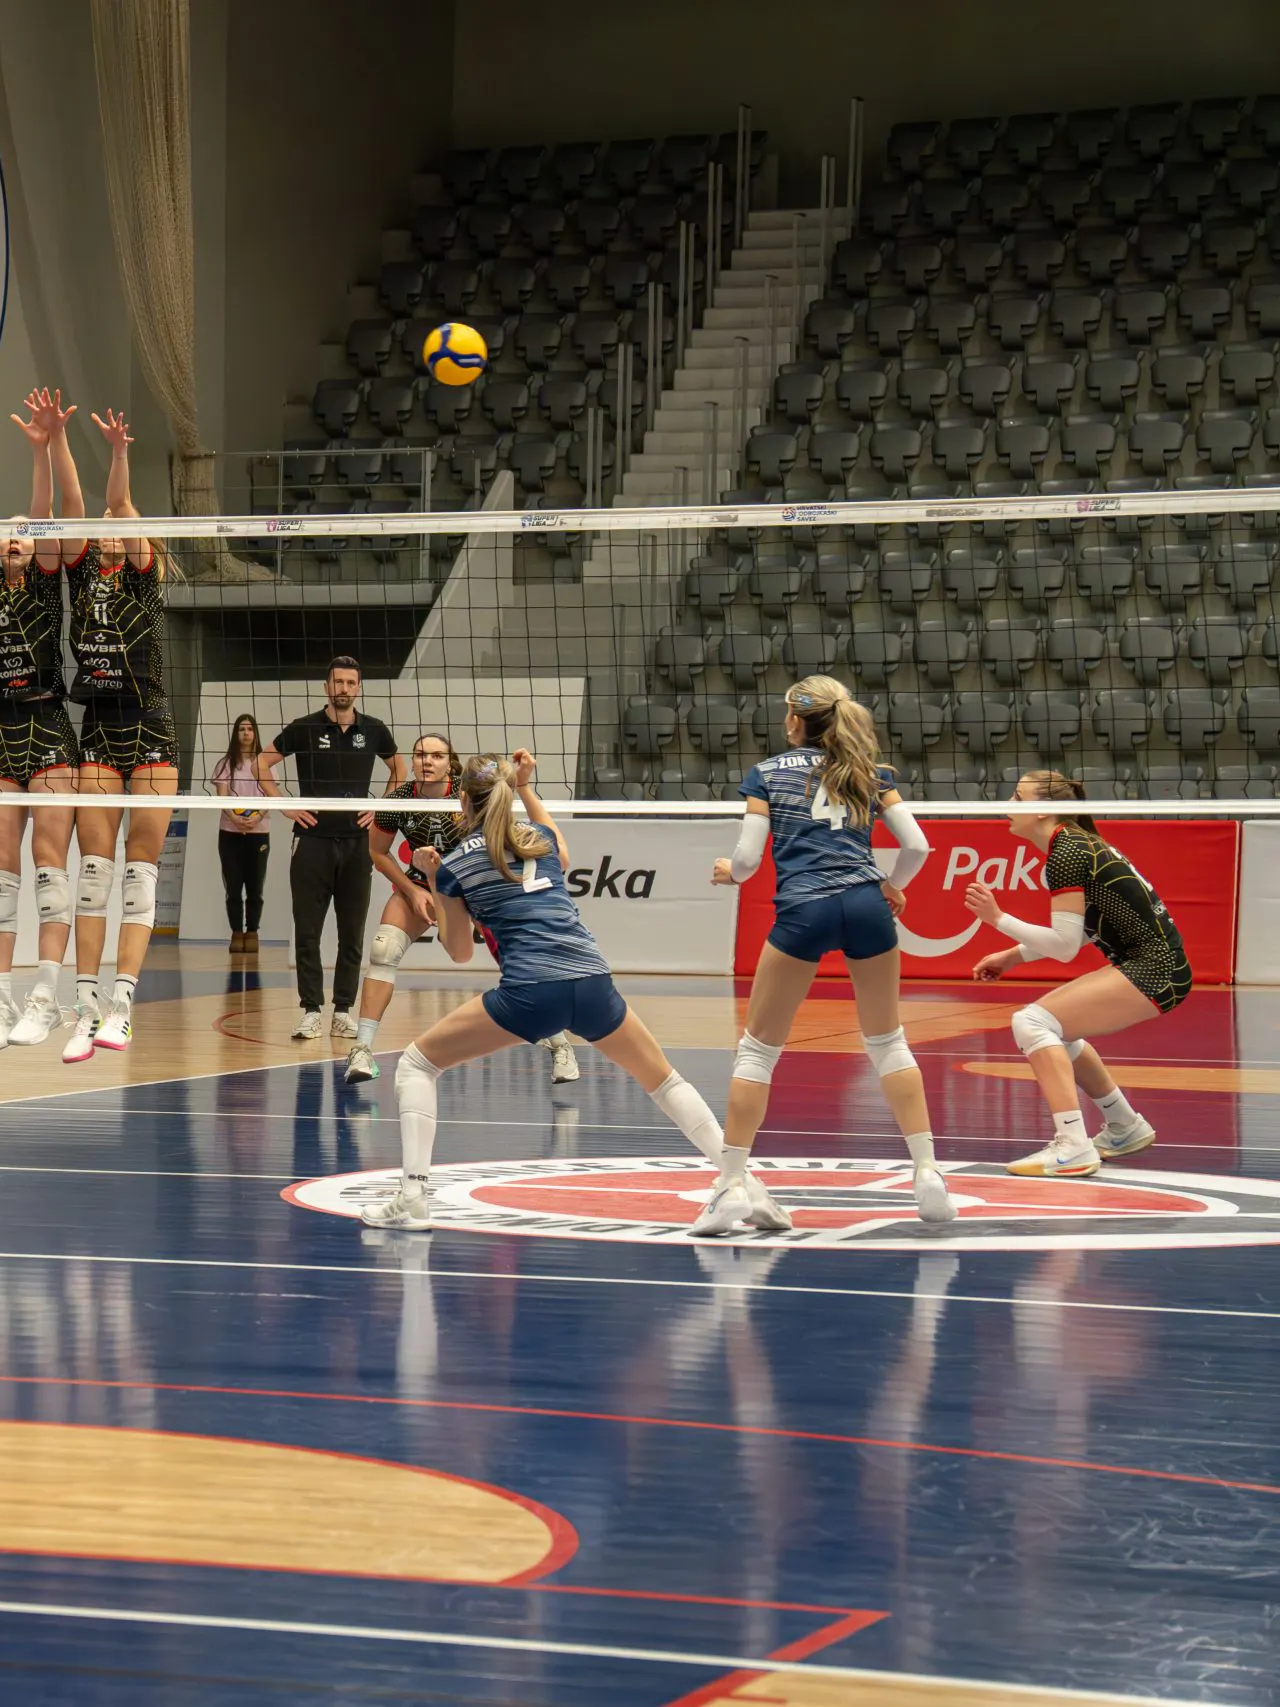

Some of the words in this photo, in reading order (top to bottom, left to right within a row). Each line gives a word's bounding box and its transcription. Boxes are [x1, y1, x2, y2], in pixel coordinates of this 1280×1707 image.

[94, 603, 108, 626] 11
[77, 643, 127, 652] FAVBET
[811, 783, 848, 831] 4
